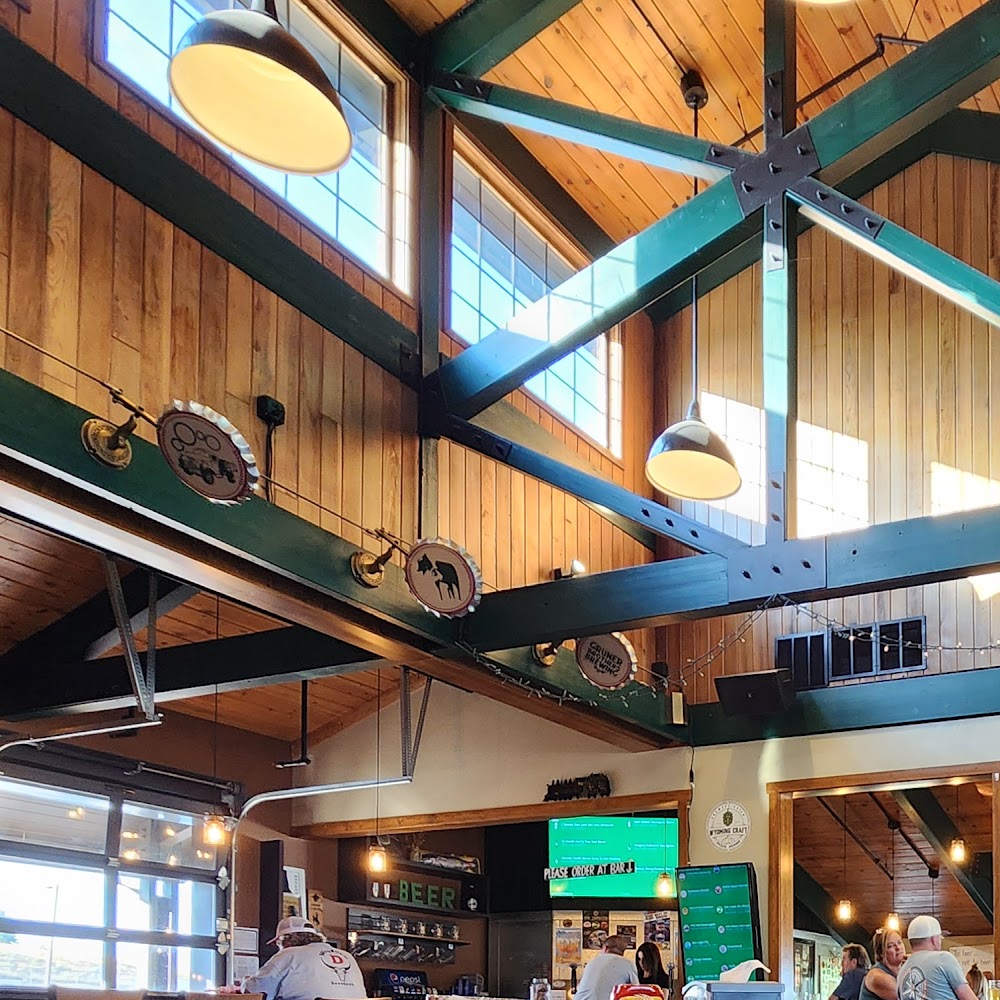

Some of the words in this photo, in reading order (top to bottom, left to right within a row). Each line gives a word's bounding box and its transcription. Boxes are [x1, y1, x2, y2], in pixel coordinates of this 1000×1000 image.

[585, 652, 617, 677] BREWING
[587, 647, 620, 672] BROTHERS
[590, 641, 623, 666] GRUNER
[543, 867, 568, 881] PLEASE
[571, 864, 595, 877] ORDER
[597, 864, 608, 875] AT
[610, 862, 625, 874] BAR
[399, 879, 455, 910] BEER
[330, 954, 343, 964] D
